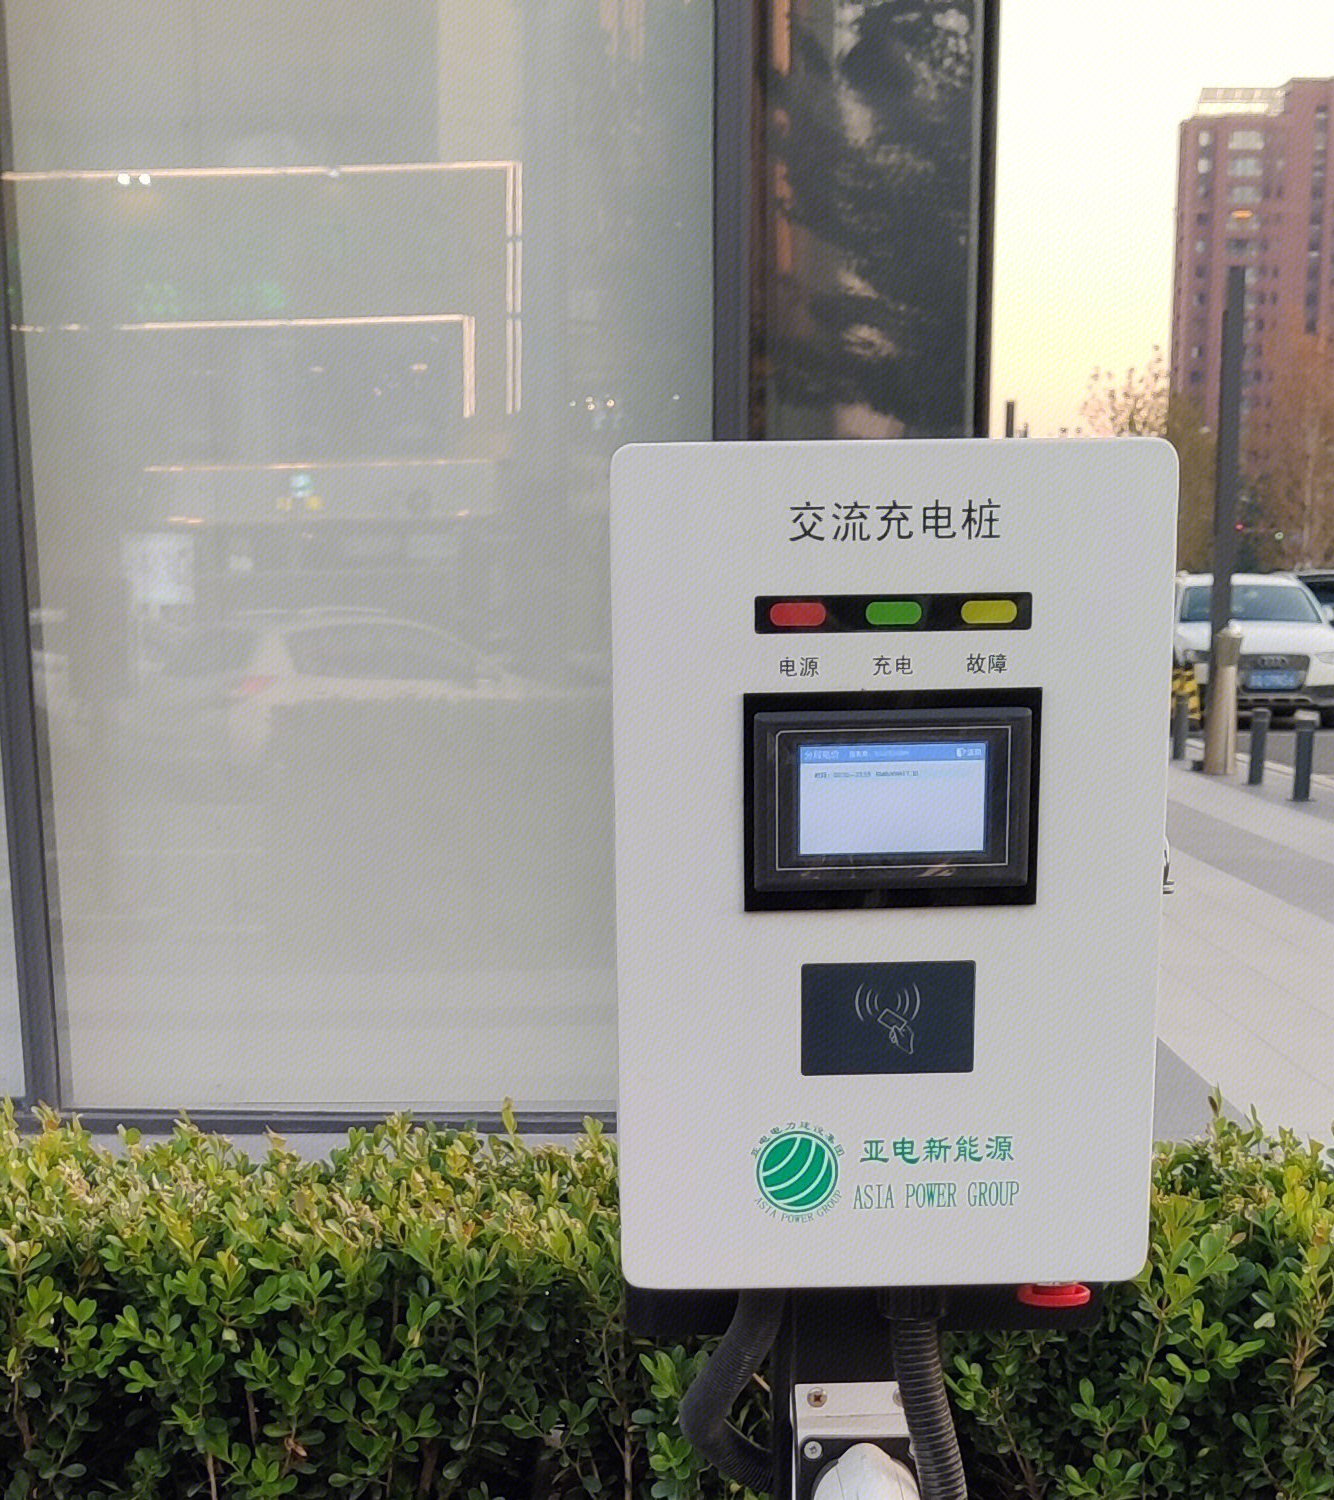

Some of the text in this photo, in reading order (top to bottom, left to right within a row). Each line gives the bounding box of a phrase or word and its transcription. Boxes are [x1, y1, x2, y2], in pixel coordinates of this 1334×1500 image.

[788, 497, 1002, 542] 交流充电桩
[779, 656, 820, 678] 电源
[872, 654, 914, 676] 充电
[966, 652, 1008, 675] 故障
[860, 1135, 1015, 1165] 亚电新能源
[754, 1190, 843, 1223] ASIA POWER GROUP
[853, 1181, 1020, 1210] ASIA POWER GROUP
